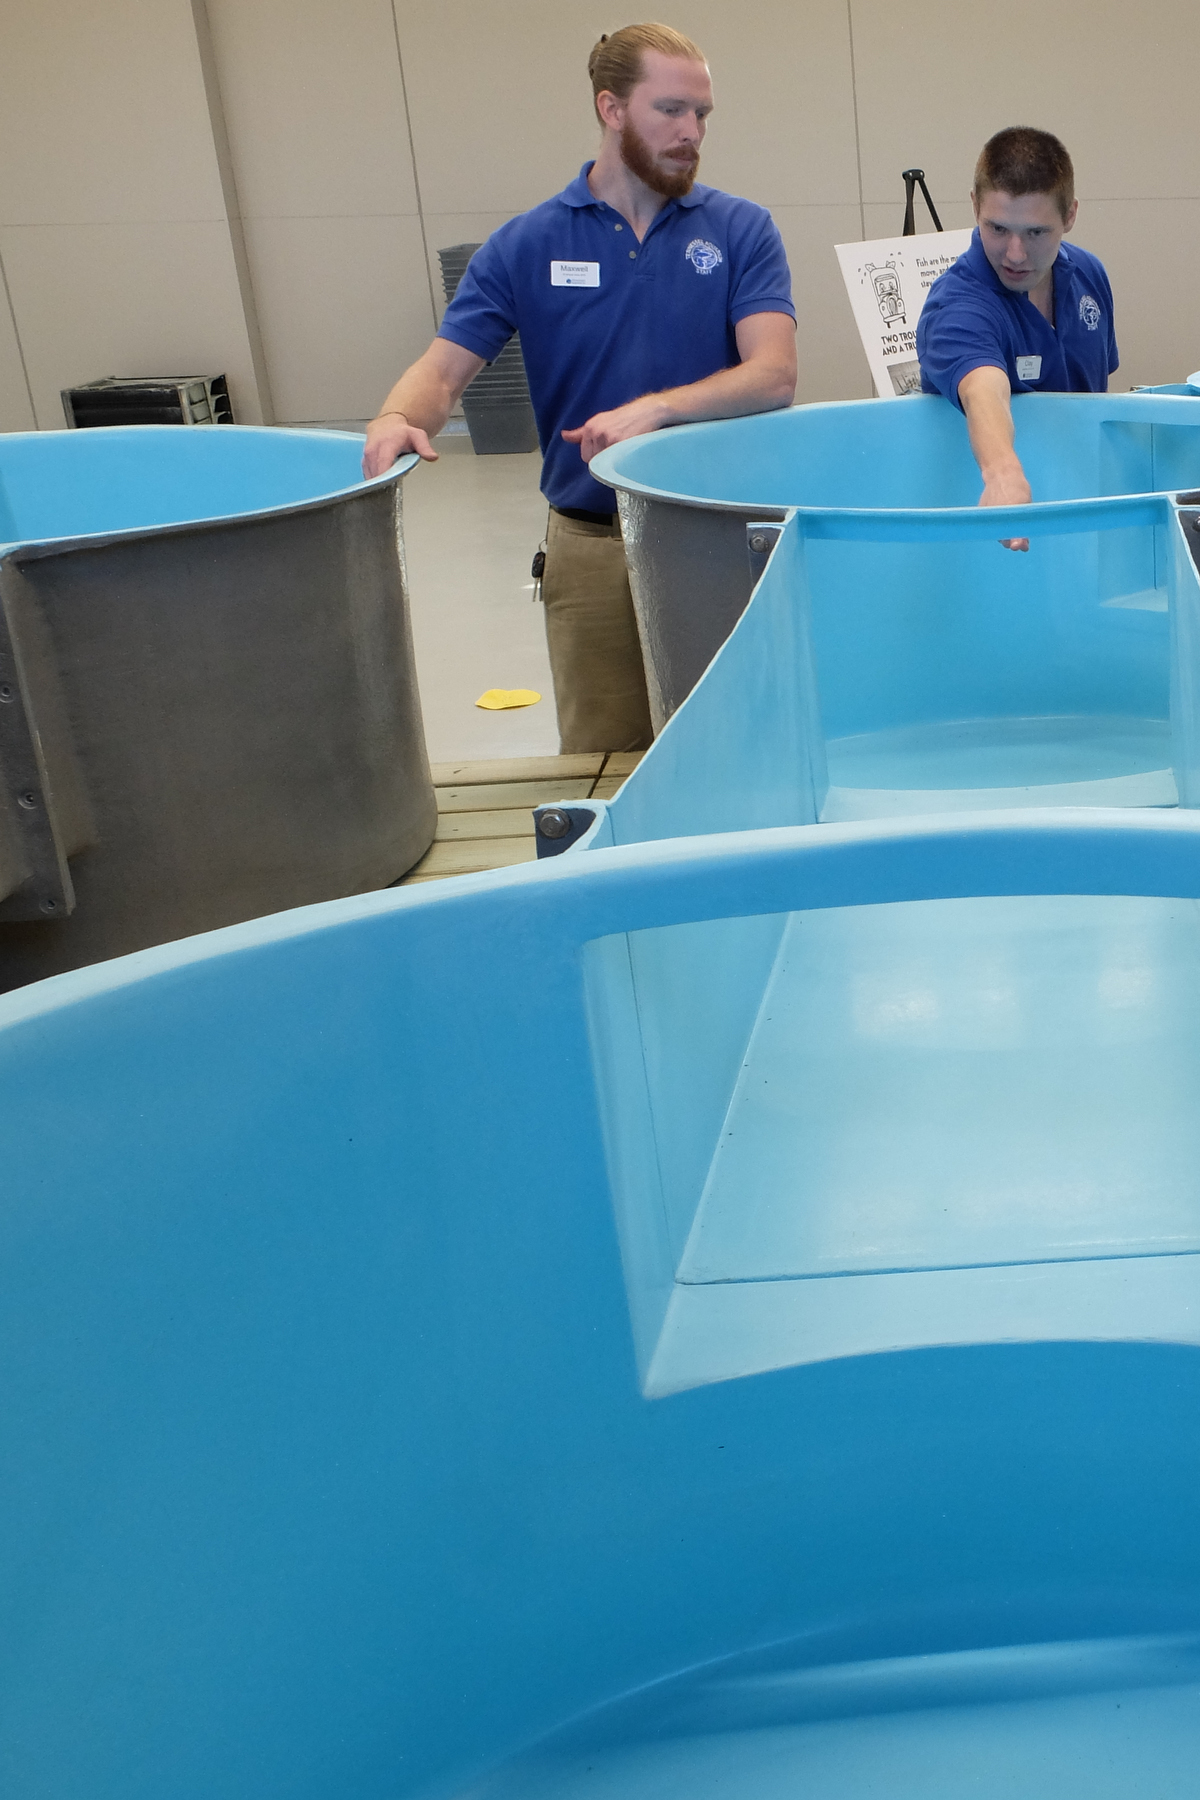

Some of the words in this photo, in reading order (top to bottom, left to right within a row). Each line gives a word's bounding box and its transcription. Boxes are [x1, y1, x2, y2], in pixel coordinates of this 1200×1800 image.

[916, 257, 928, 267] Fish
[940, 254, 950, 264] the
[881, 334, 898, 345] TWO
[883, 345, 897, 356] AND
[900, 345, 905, 353] A
